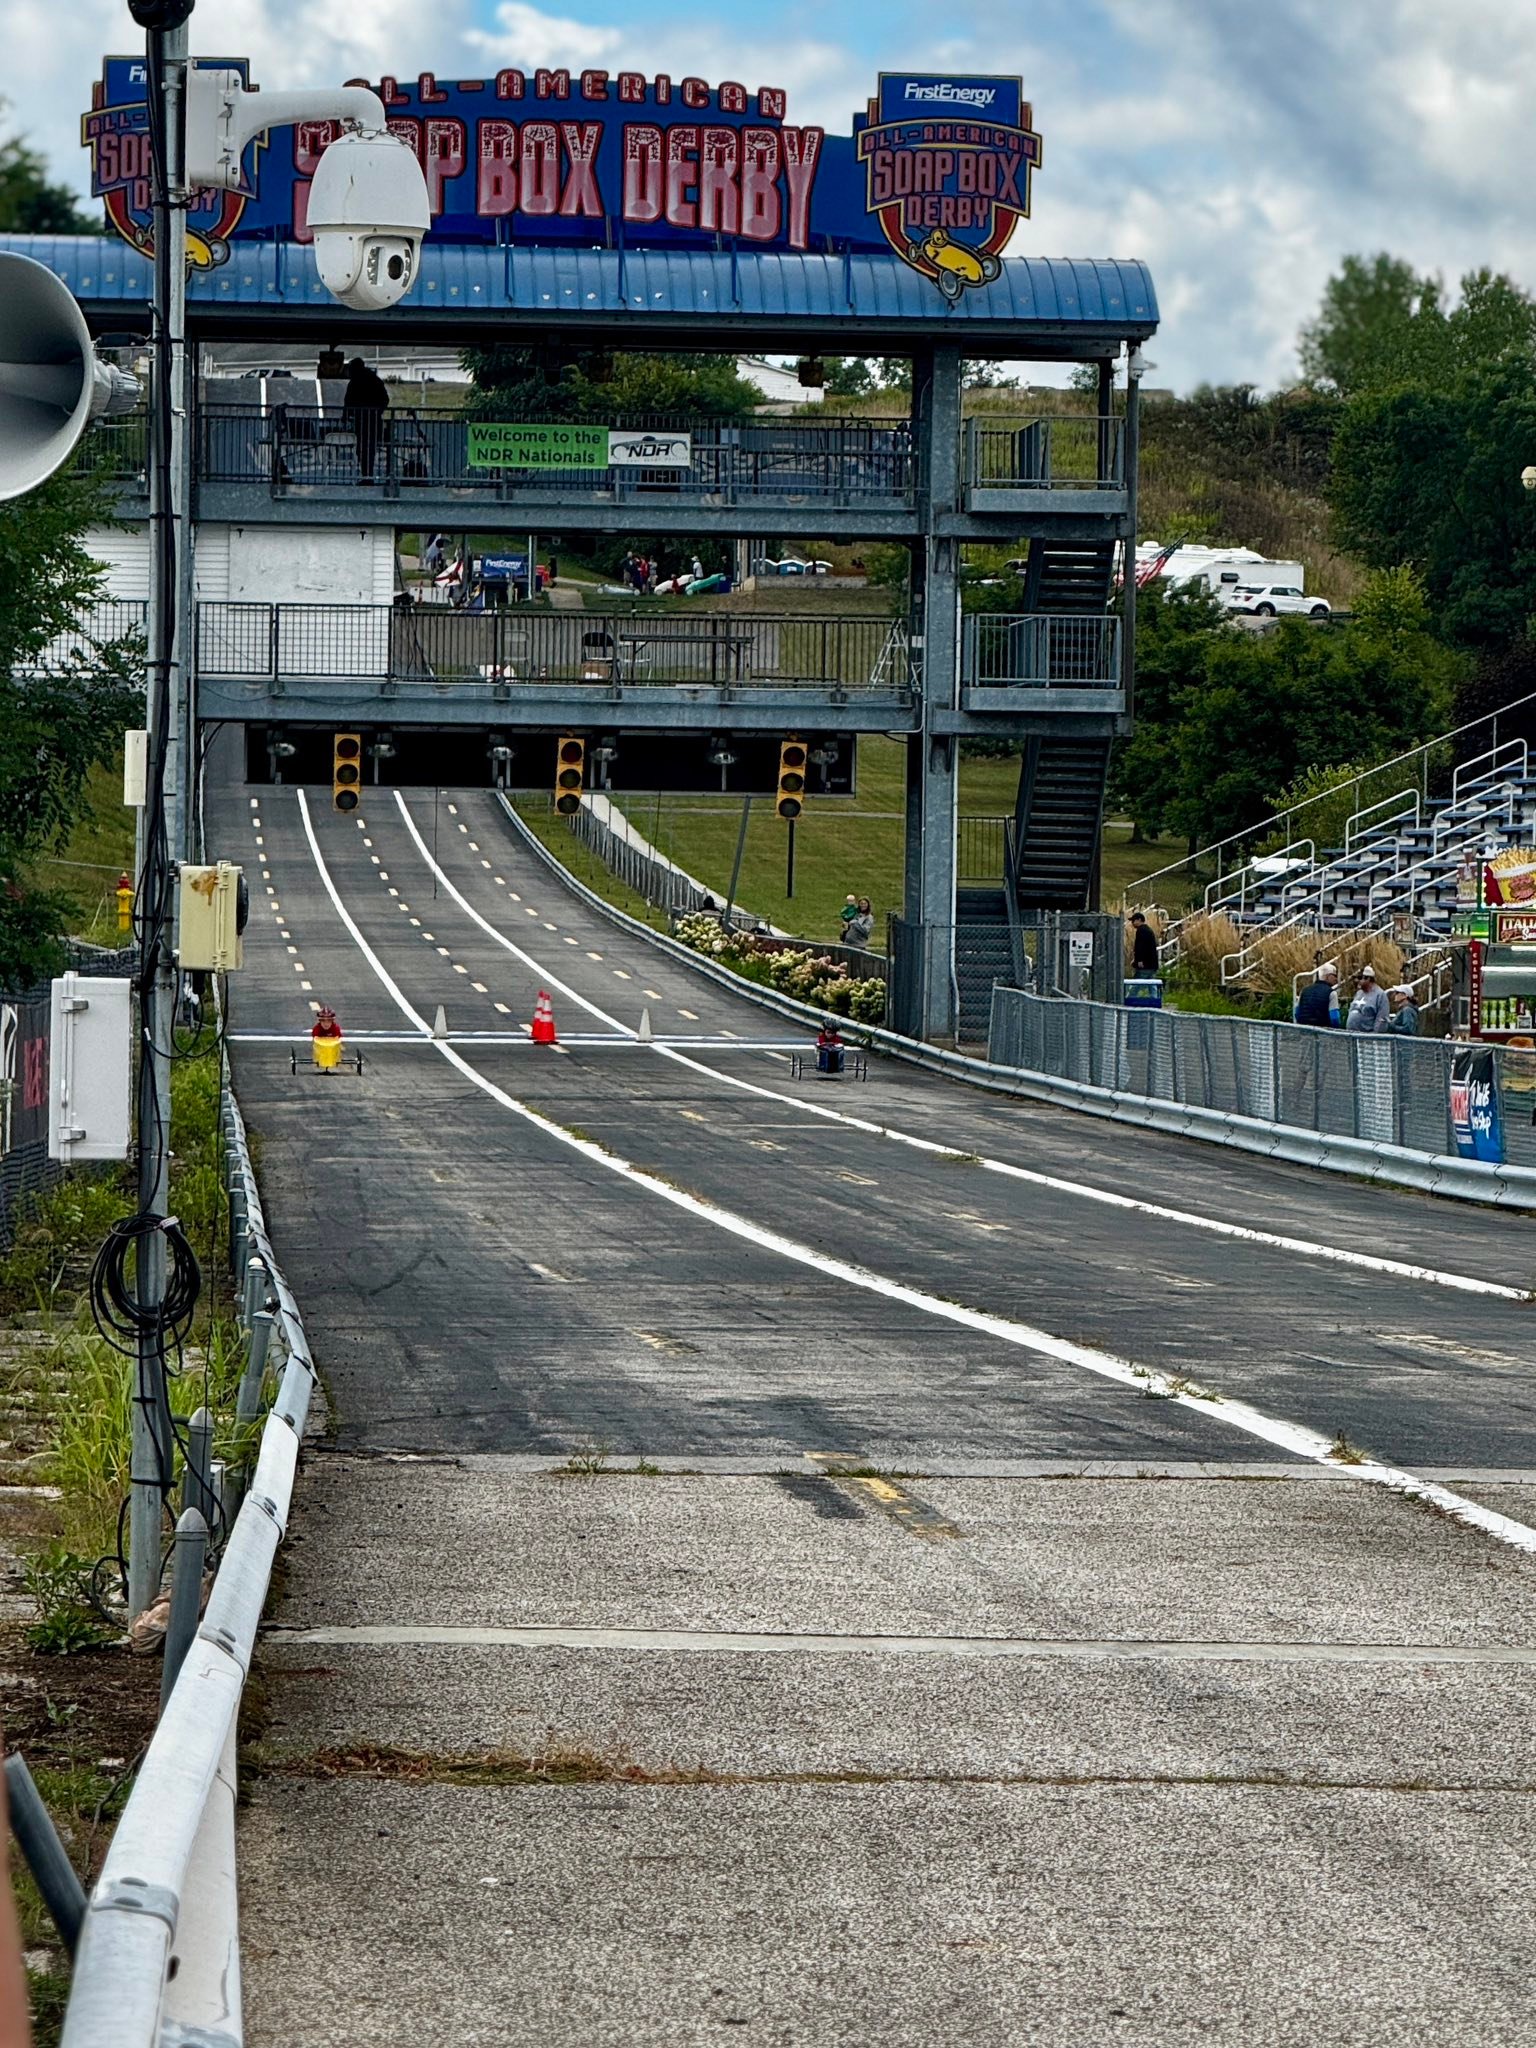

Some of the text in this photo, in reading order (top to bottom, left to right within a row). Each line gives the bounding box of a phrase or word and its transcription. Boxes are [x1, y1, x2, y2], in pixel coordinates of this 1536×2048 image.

[343, 68, 786, 119] LL-AMERICAN
[904, 82, 996, 104] FirstEnergy
[862, 125, 1036, 157] ALL-AMERICAN
[478, 118, 604, 217] BOX
[622, 122, 825, 249] DERBY
[874, 150, 1022, 207] SOAP BOX
[906, 196, 990, 229] DERBY
[472, 428, 601, 444] Welcome to the
[477, 448, 595, 463] NDR Nationals
[628, 443, 671, 458] NDR
[1502, 917, 1536, 931] ITALI
